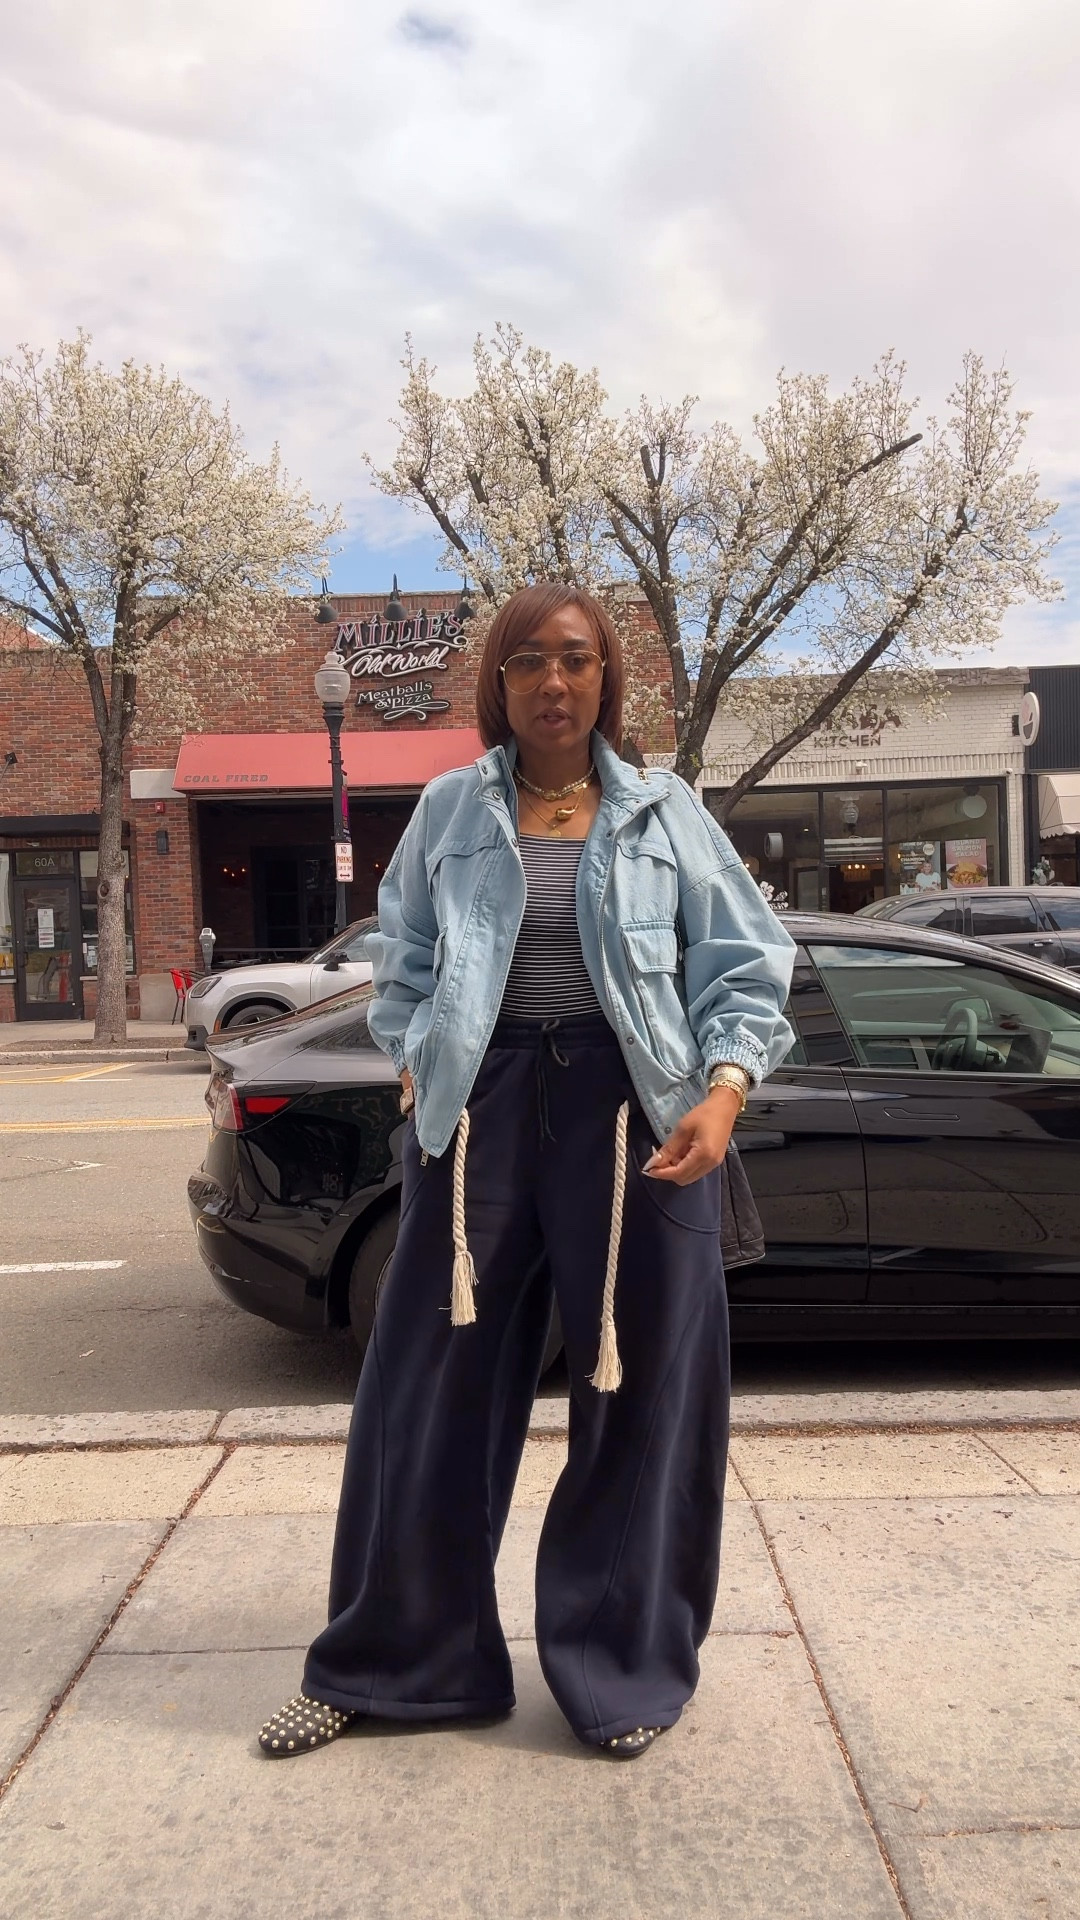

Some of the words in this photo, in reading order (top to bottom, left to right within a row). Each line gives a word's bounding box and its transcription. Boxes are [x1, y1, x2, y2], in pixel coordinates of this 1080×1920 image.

[351, 653, 391, 677] Old
[390, 646, 449, 673] World
[357, 681, 433, 704] Meatballs
[374, 699, 389, 709] &
[388, 693, 432, 709] Pizza
[183, 775, 220, 783] COAL
[225, 774, 269, 782] FIRED
[340, 846, 348, 854] NO
[35, 857, 55, 867] 60A
